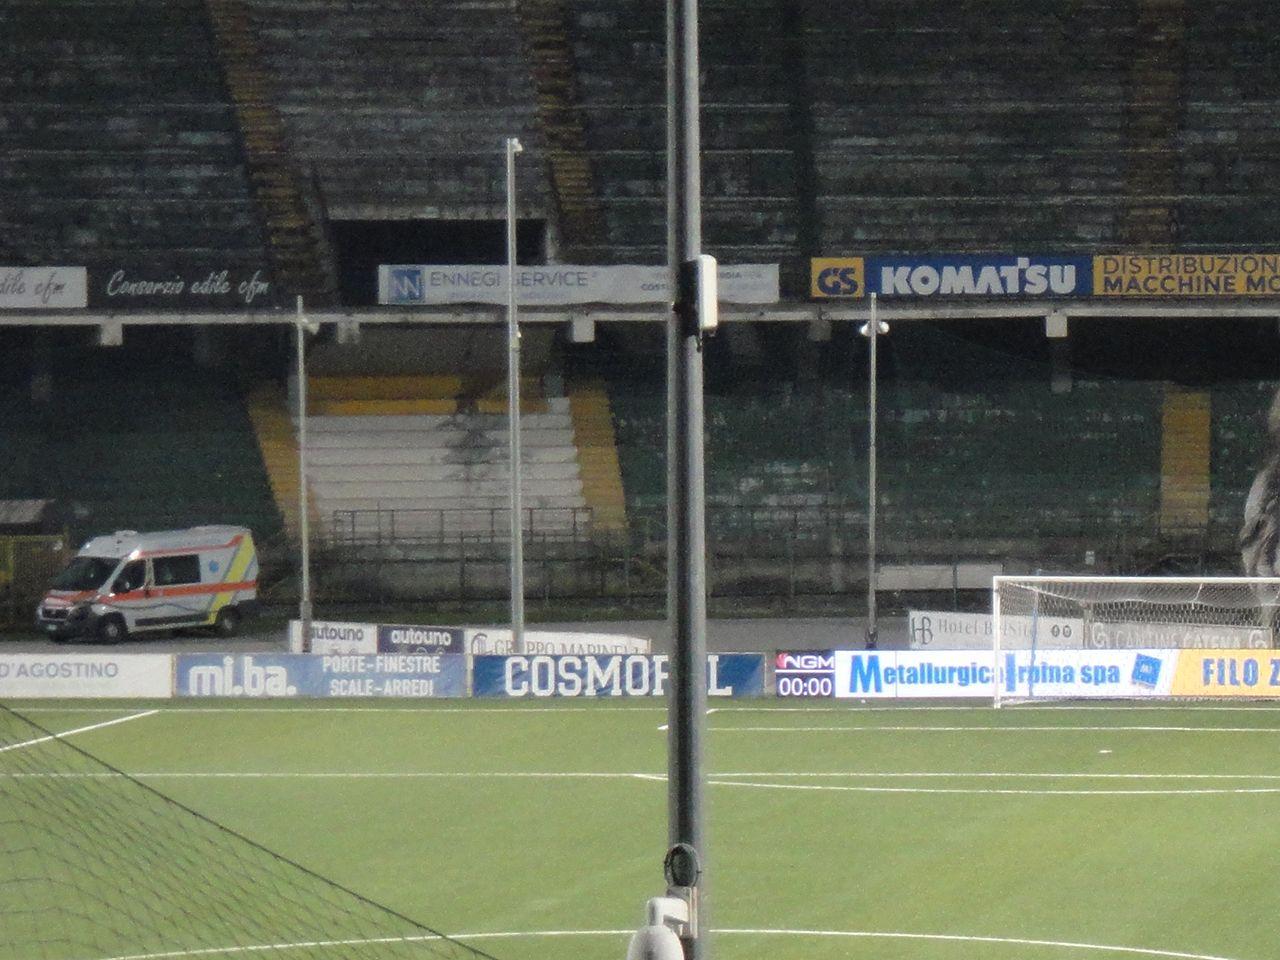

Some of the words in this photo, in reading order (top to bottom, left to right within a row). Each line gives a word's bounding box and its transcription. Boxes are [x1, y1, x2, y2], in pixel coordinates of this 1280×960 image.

[106, 269, 182, 296] Consorzio
[191, 270, 230, 295] edile
[881, 257, 1076, 295] KOMATSU
[1103, 275, 1236, 293] MACCHINE
[938, 618, 978, 635] Hotel
[391, 628, 452, 646] autouno
[494, 640, 555, 654] GRPPO
[322, 655, 441, 673] PORTE-FINESTRE
[783, 655, 835, 669] NGM
[189, 656, 297, 696] mi.ba.
[1081, 665, 1120, 686] spa
[1203, 658, 1259, 687] FILO
[329, 679, 434, 697] SCALE-ARREDI
[779, 677, 832, 696] 00:00
